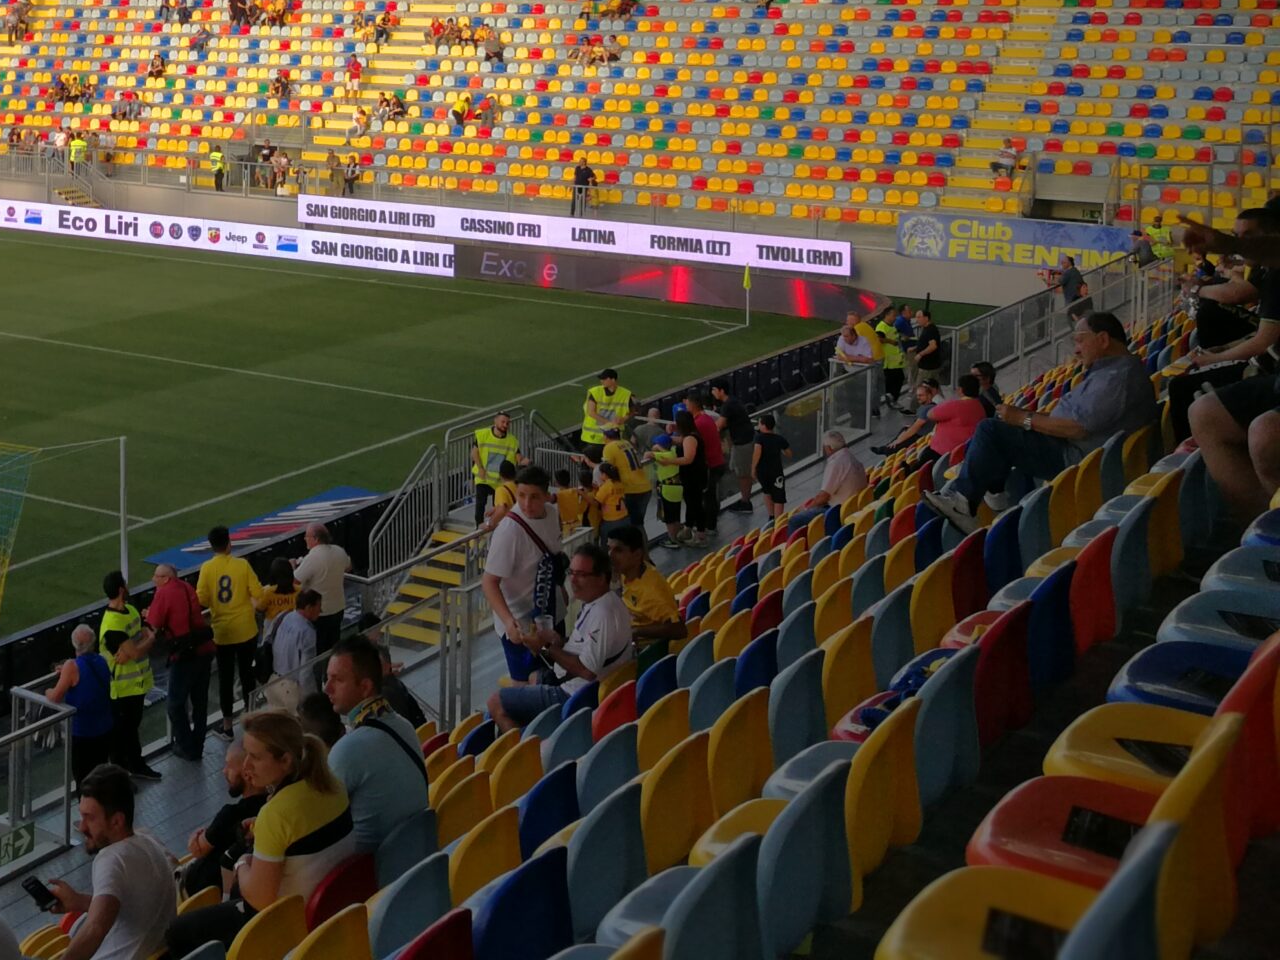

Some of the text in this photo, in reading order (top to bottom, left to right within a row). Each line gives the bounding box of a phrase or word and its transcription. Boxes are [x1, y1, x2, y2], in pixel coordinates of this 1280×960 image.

[58, 210, 98, 232] Eco
[105, 214, 138, 237] Liri
[225, 232, 248, 244] Jeep
[311, 240, 338, 257] SAN
[341, 244, 398, 263] GIORGIO
[400, 249, 410, 265] A
[413, 250, 440, 268] LIRI
[306, 203, 843, 268] SAN GIORGIO A LIRI (FR) CASSINO (FR) LATINA FORMIA (LT) TIVOLI (RM)
[950, 218, 1013, 241] Club
[218, 575, 232, 603] 8
